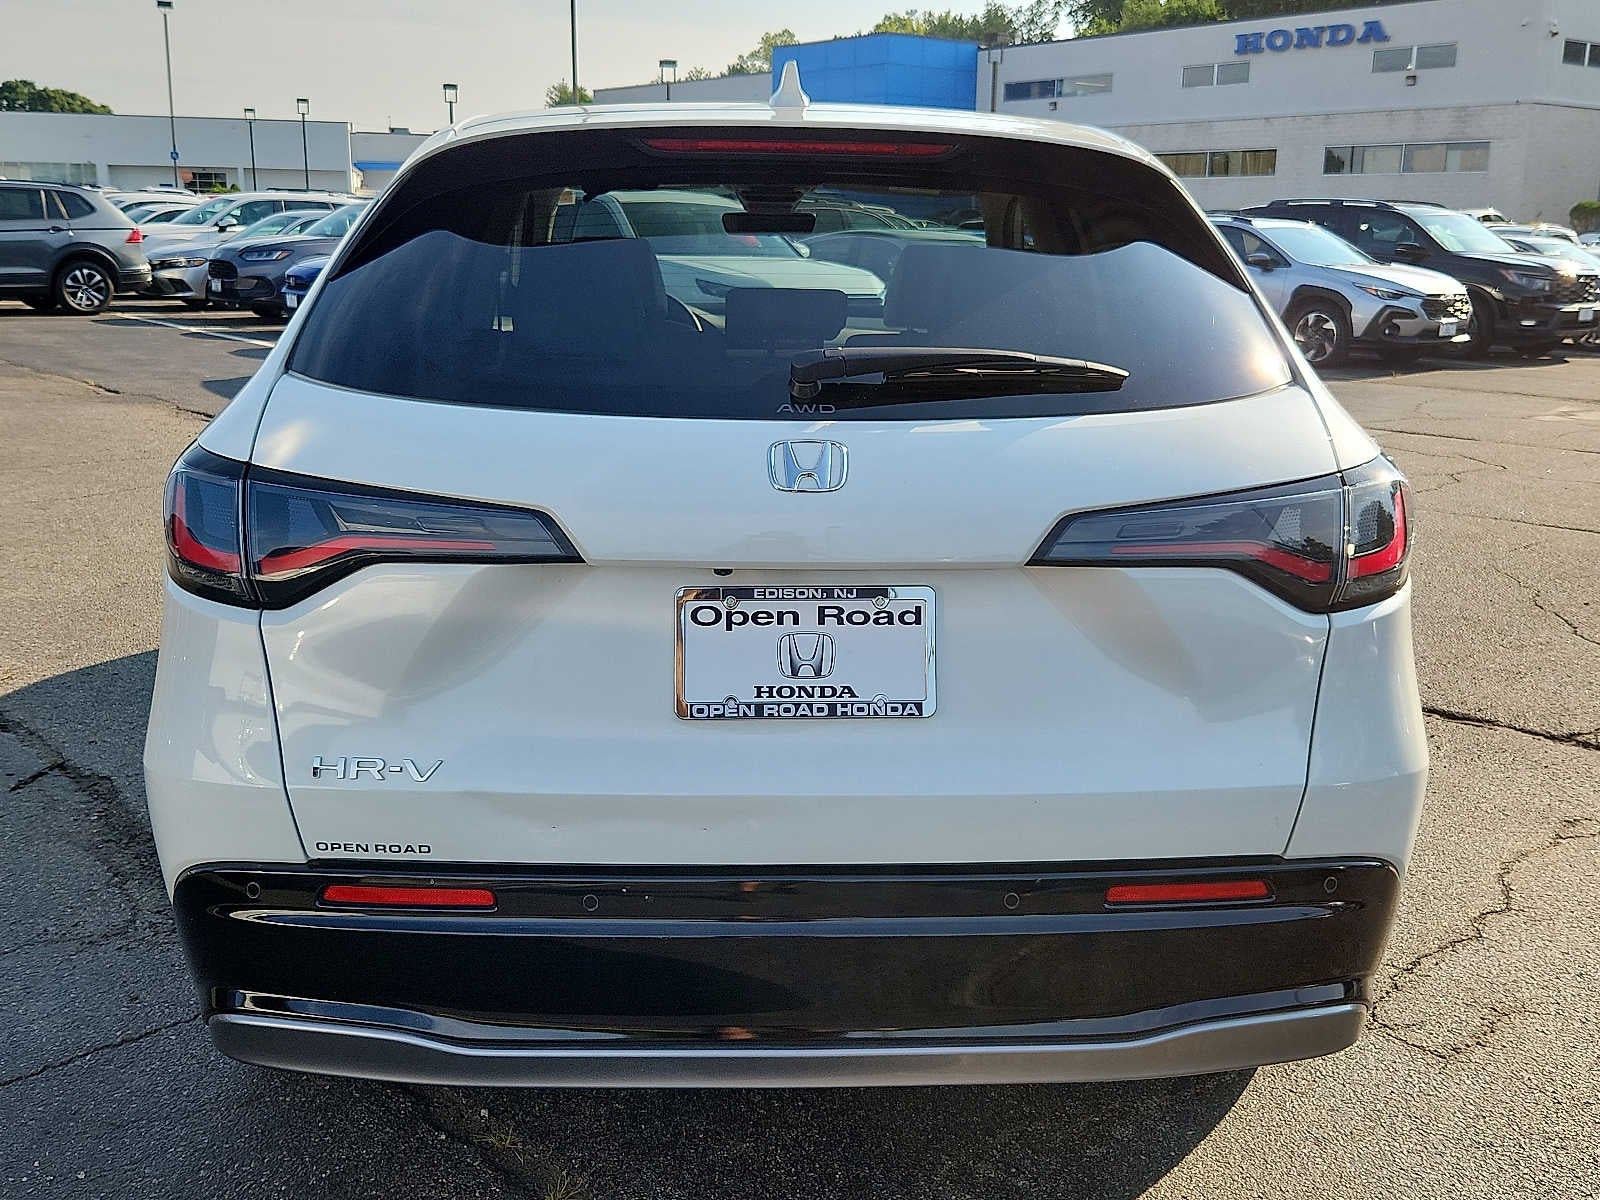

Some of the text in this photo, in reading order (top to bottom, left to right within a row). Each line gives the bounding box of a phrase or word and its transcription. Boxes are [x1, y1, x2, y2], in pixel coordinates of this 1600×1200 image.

[1234, 20, 1390, 55] HONDA
[777, 403, 836, 414] AWD
[833, 588, 858, 600] NJ
[690, 604, 922, 632] Open Road
[753, 685, 860, 699] HONDA
[692, 702, 921, 718] OPEN ROAD HONDA
[312, 755, 445, 783] HR-V
[315, 841, 432, 855] OPEN ROAD
